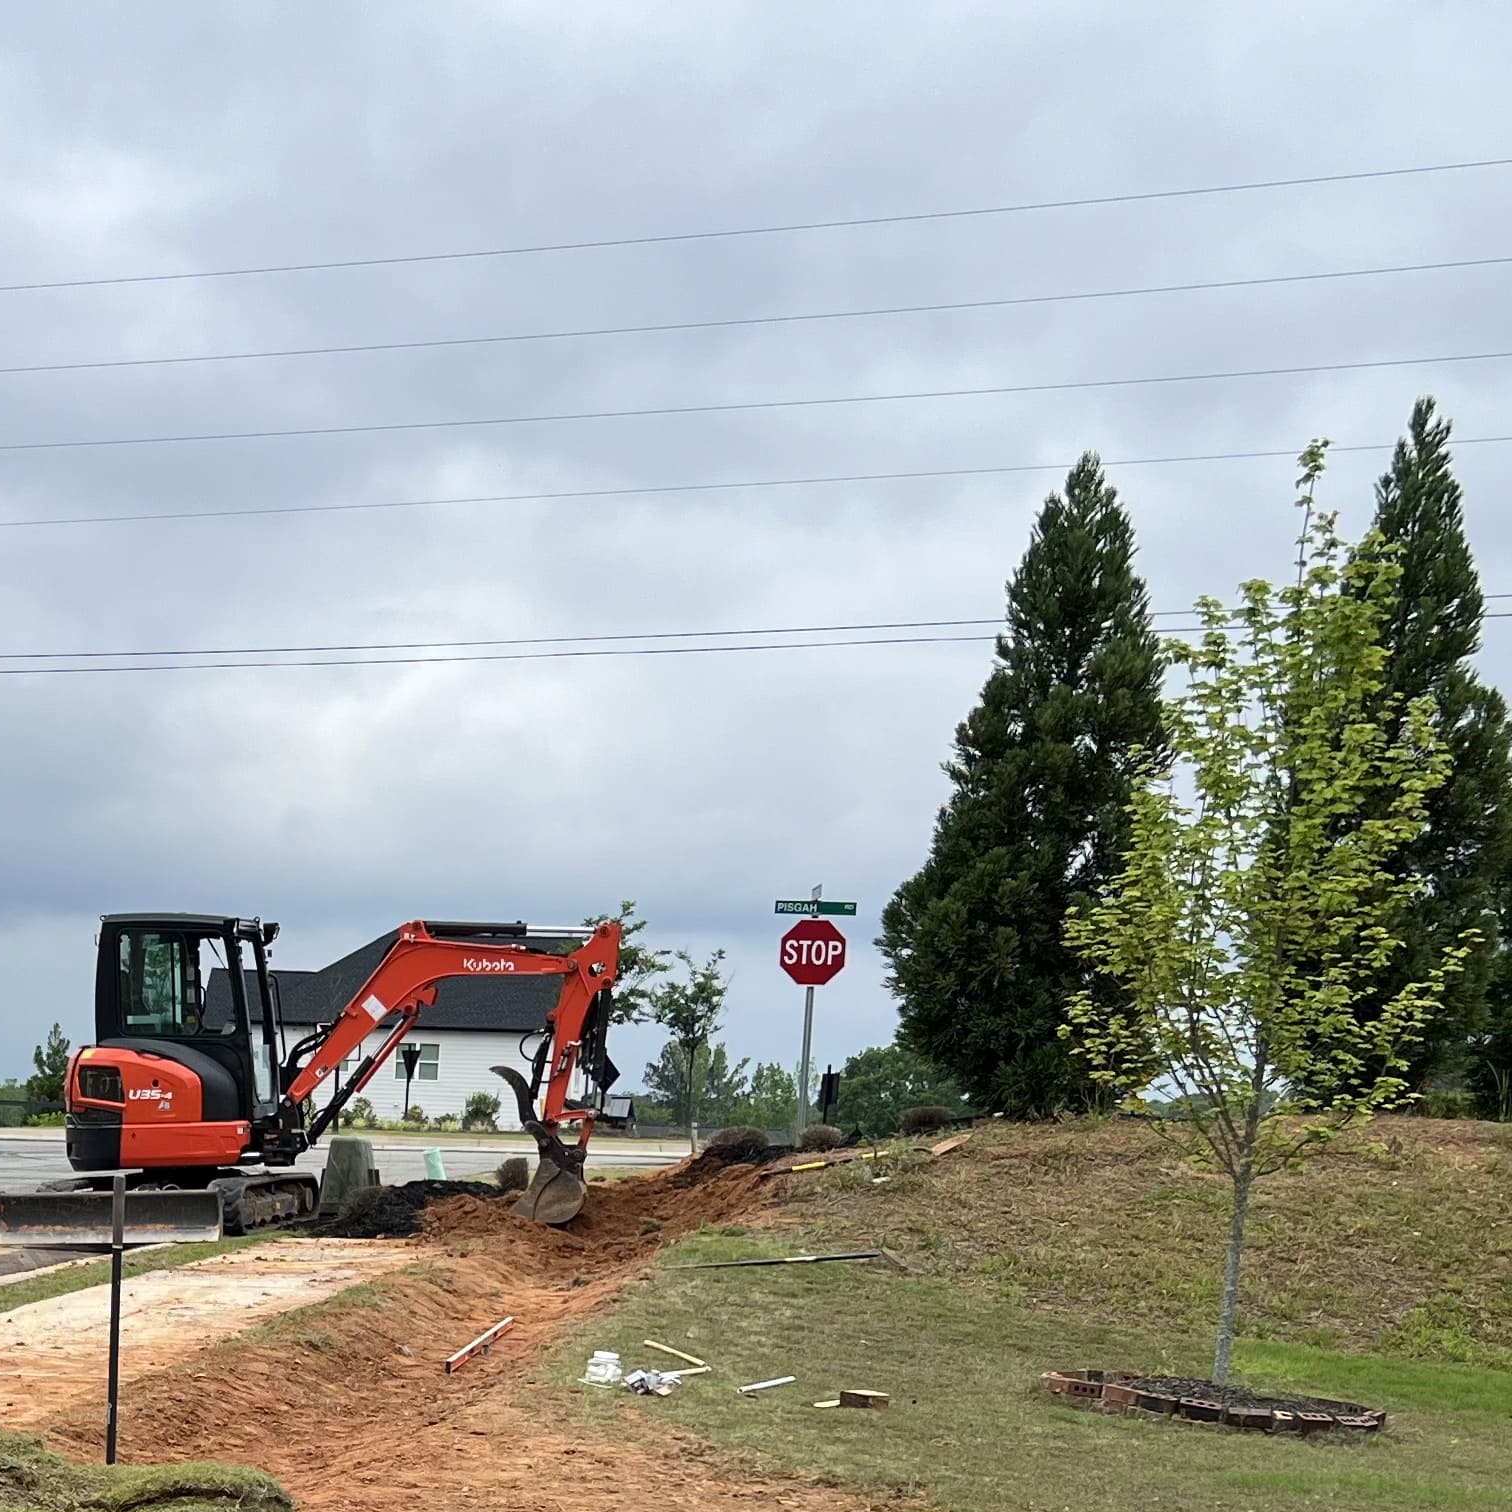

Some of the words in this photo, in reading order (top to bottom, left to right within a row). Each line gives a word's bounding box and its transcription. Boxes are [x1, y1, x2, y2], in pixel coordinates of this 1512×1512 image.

[776, 902, 818, 913] PISGAH
[783, 939, 843, 966] STOP
[463, 958, 515, 971] Kubota
[128, 1089, 173, 1100] U35-4
